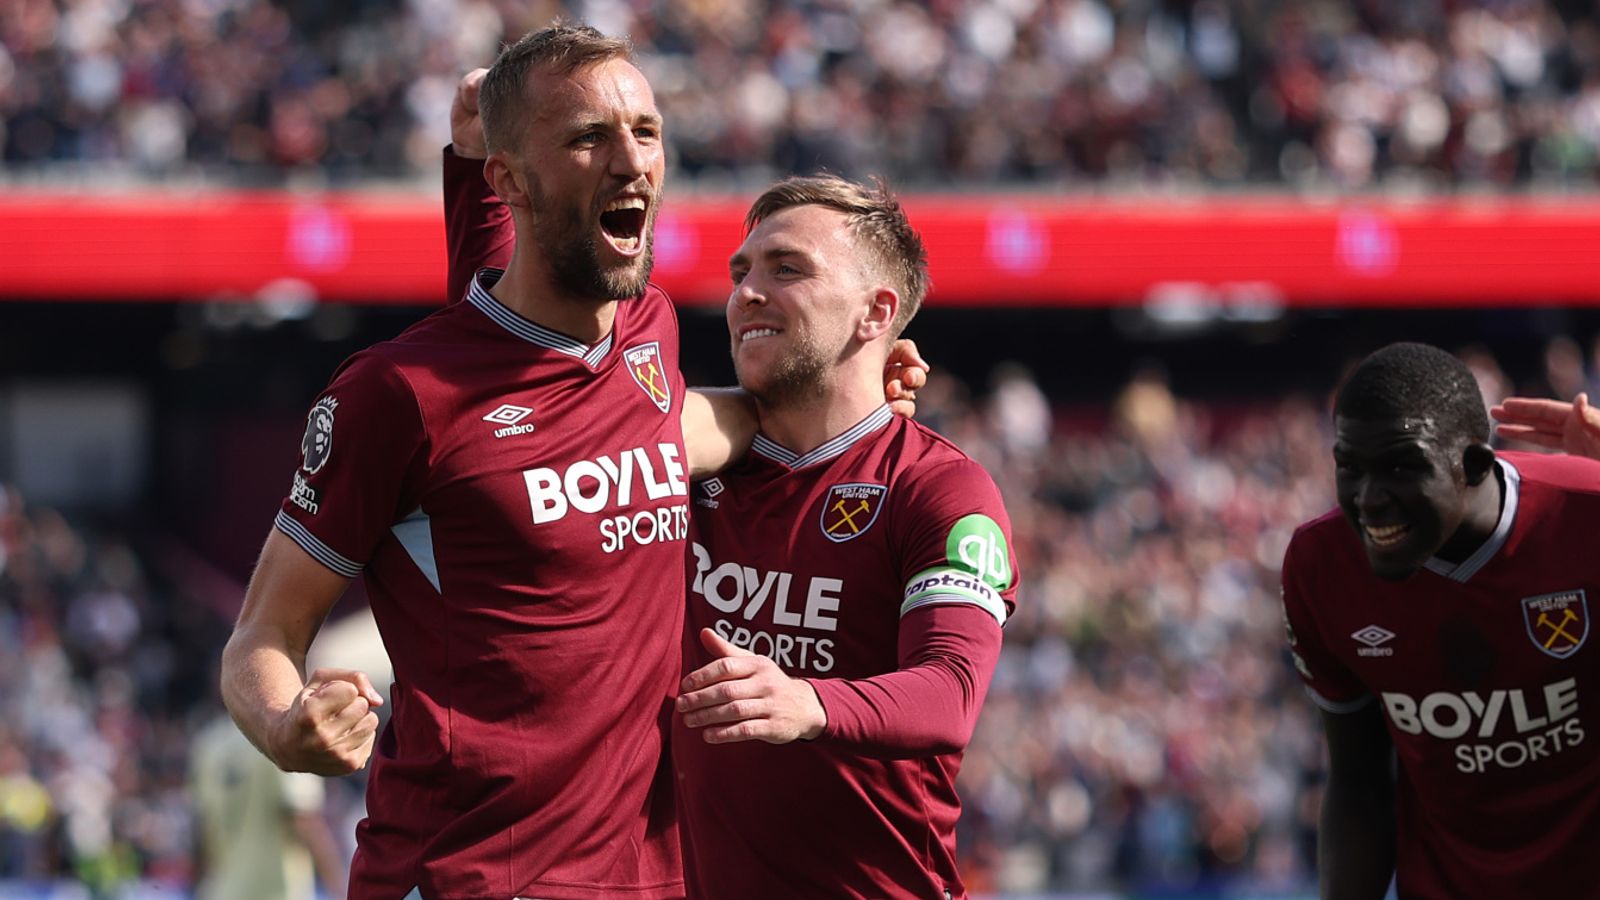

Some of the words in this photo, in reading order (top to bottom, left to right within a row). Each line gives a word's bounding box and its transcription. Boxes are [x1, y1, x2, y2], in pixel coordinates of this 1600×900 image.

[494, 423, 534, 438] umbro
[522, 443, 688, 525] BOYLE
[835, 487, 856, 496] WEST
[859, 487, 880, 496] HAM
[600, 504, 688, 553] SPORTS
[715, 619, 835, 673] SPORTS
[1381, 677, 1580, 739] BOYLE
[1455, 718, 1585, 773] SPORTS
